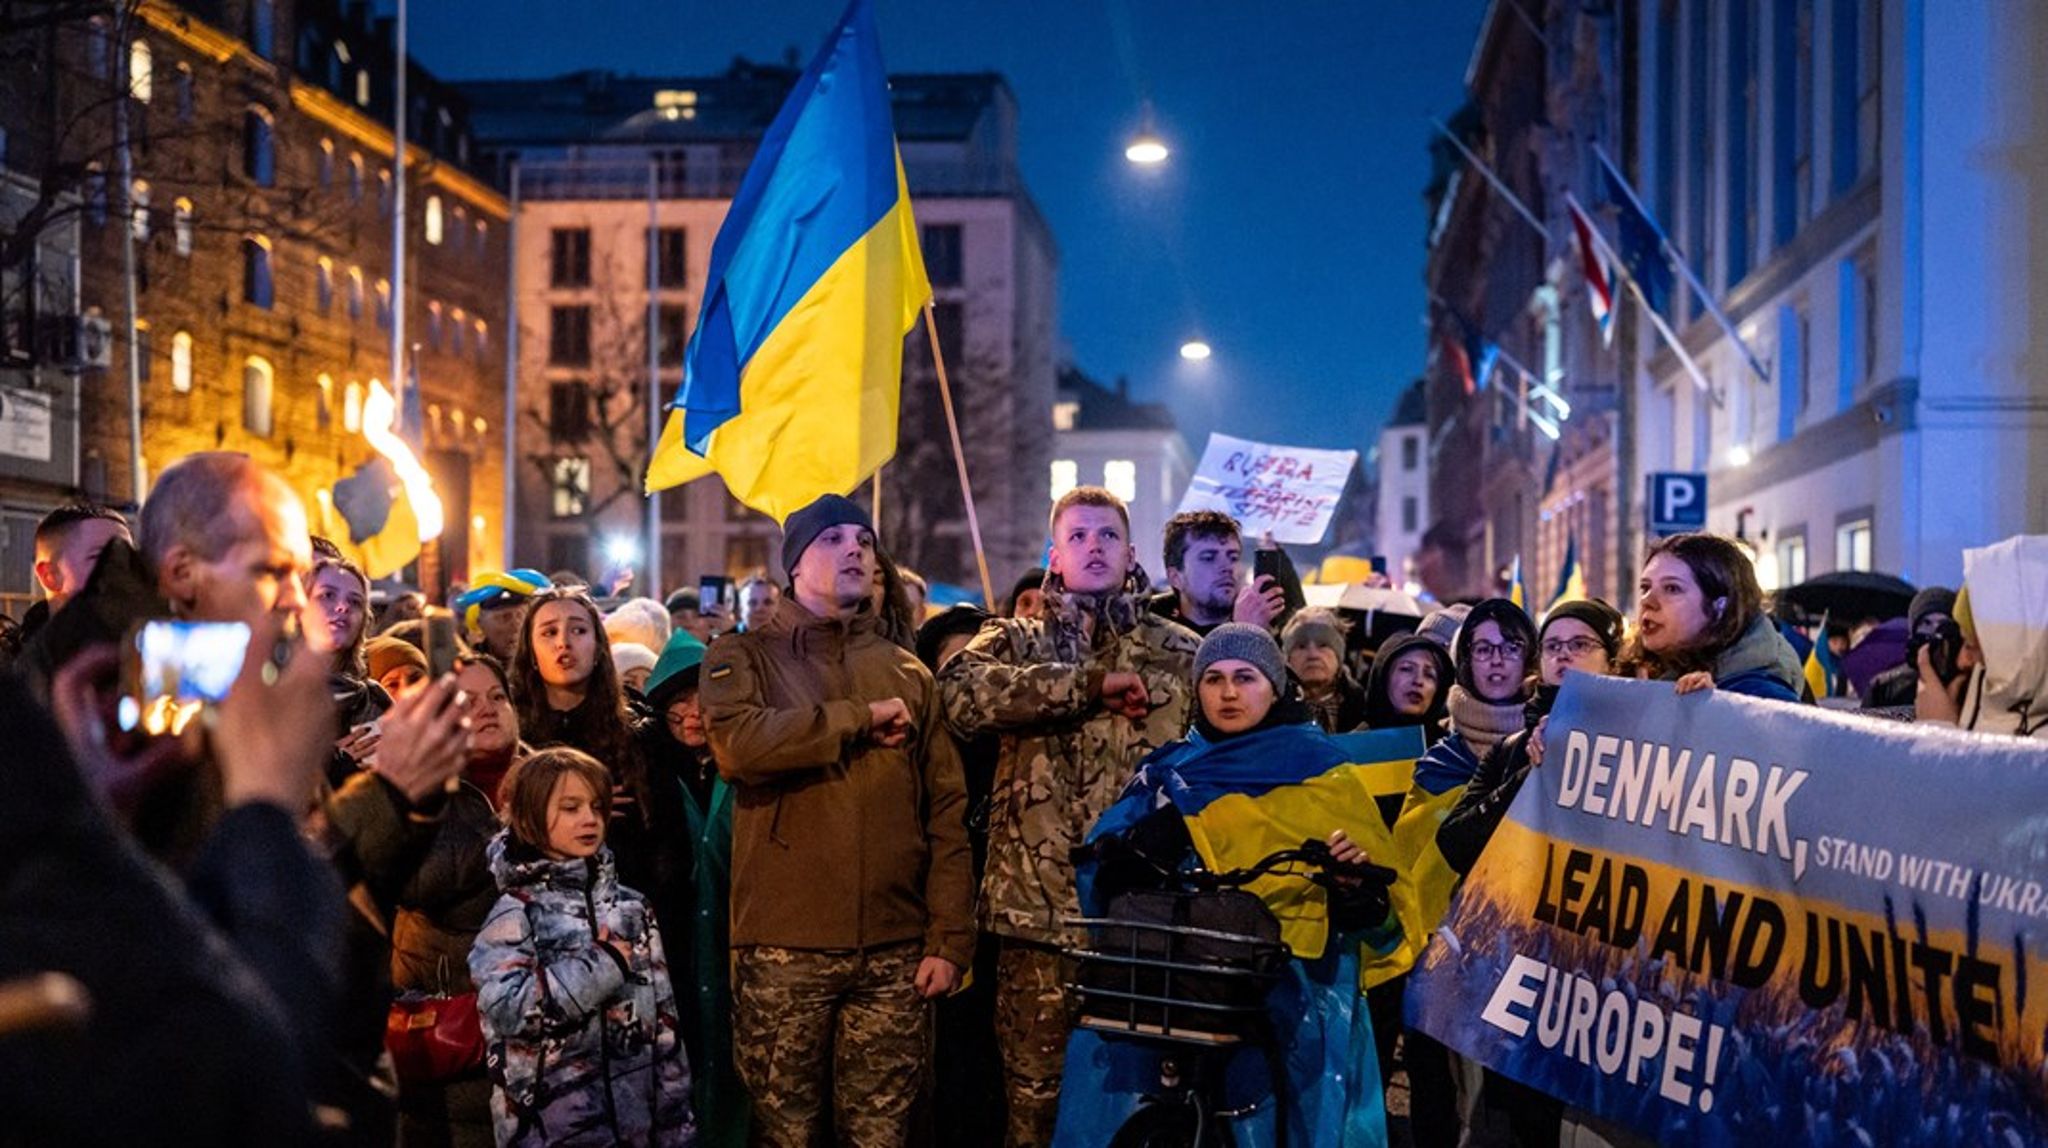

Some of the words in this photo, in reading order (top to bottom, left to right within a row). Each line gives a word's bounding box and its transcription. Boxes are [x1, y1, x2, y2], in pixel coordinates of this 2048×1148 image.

[1664, 478, 1695, 520] P
[1557, 729, 1809, 883] DENMARK,
[1815, 836, 1893, 881] STAND
[1899, 854, 1973, 899] WITH
[1481, 954, 1725, 1114] EUROPE!
[1533, 843, 1649, 950] LEAD
[1651, 878, 1787, 988] AND
[1800, 911, 2003, 1064] UNITE
